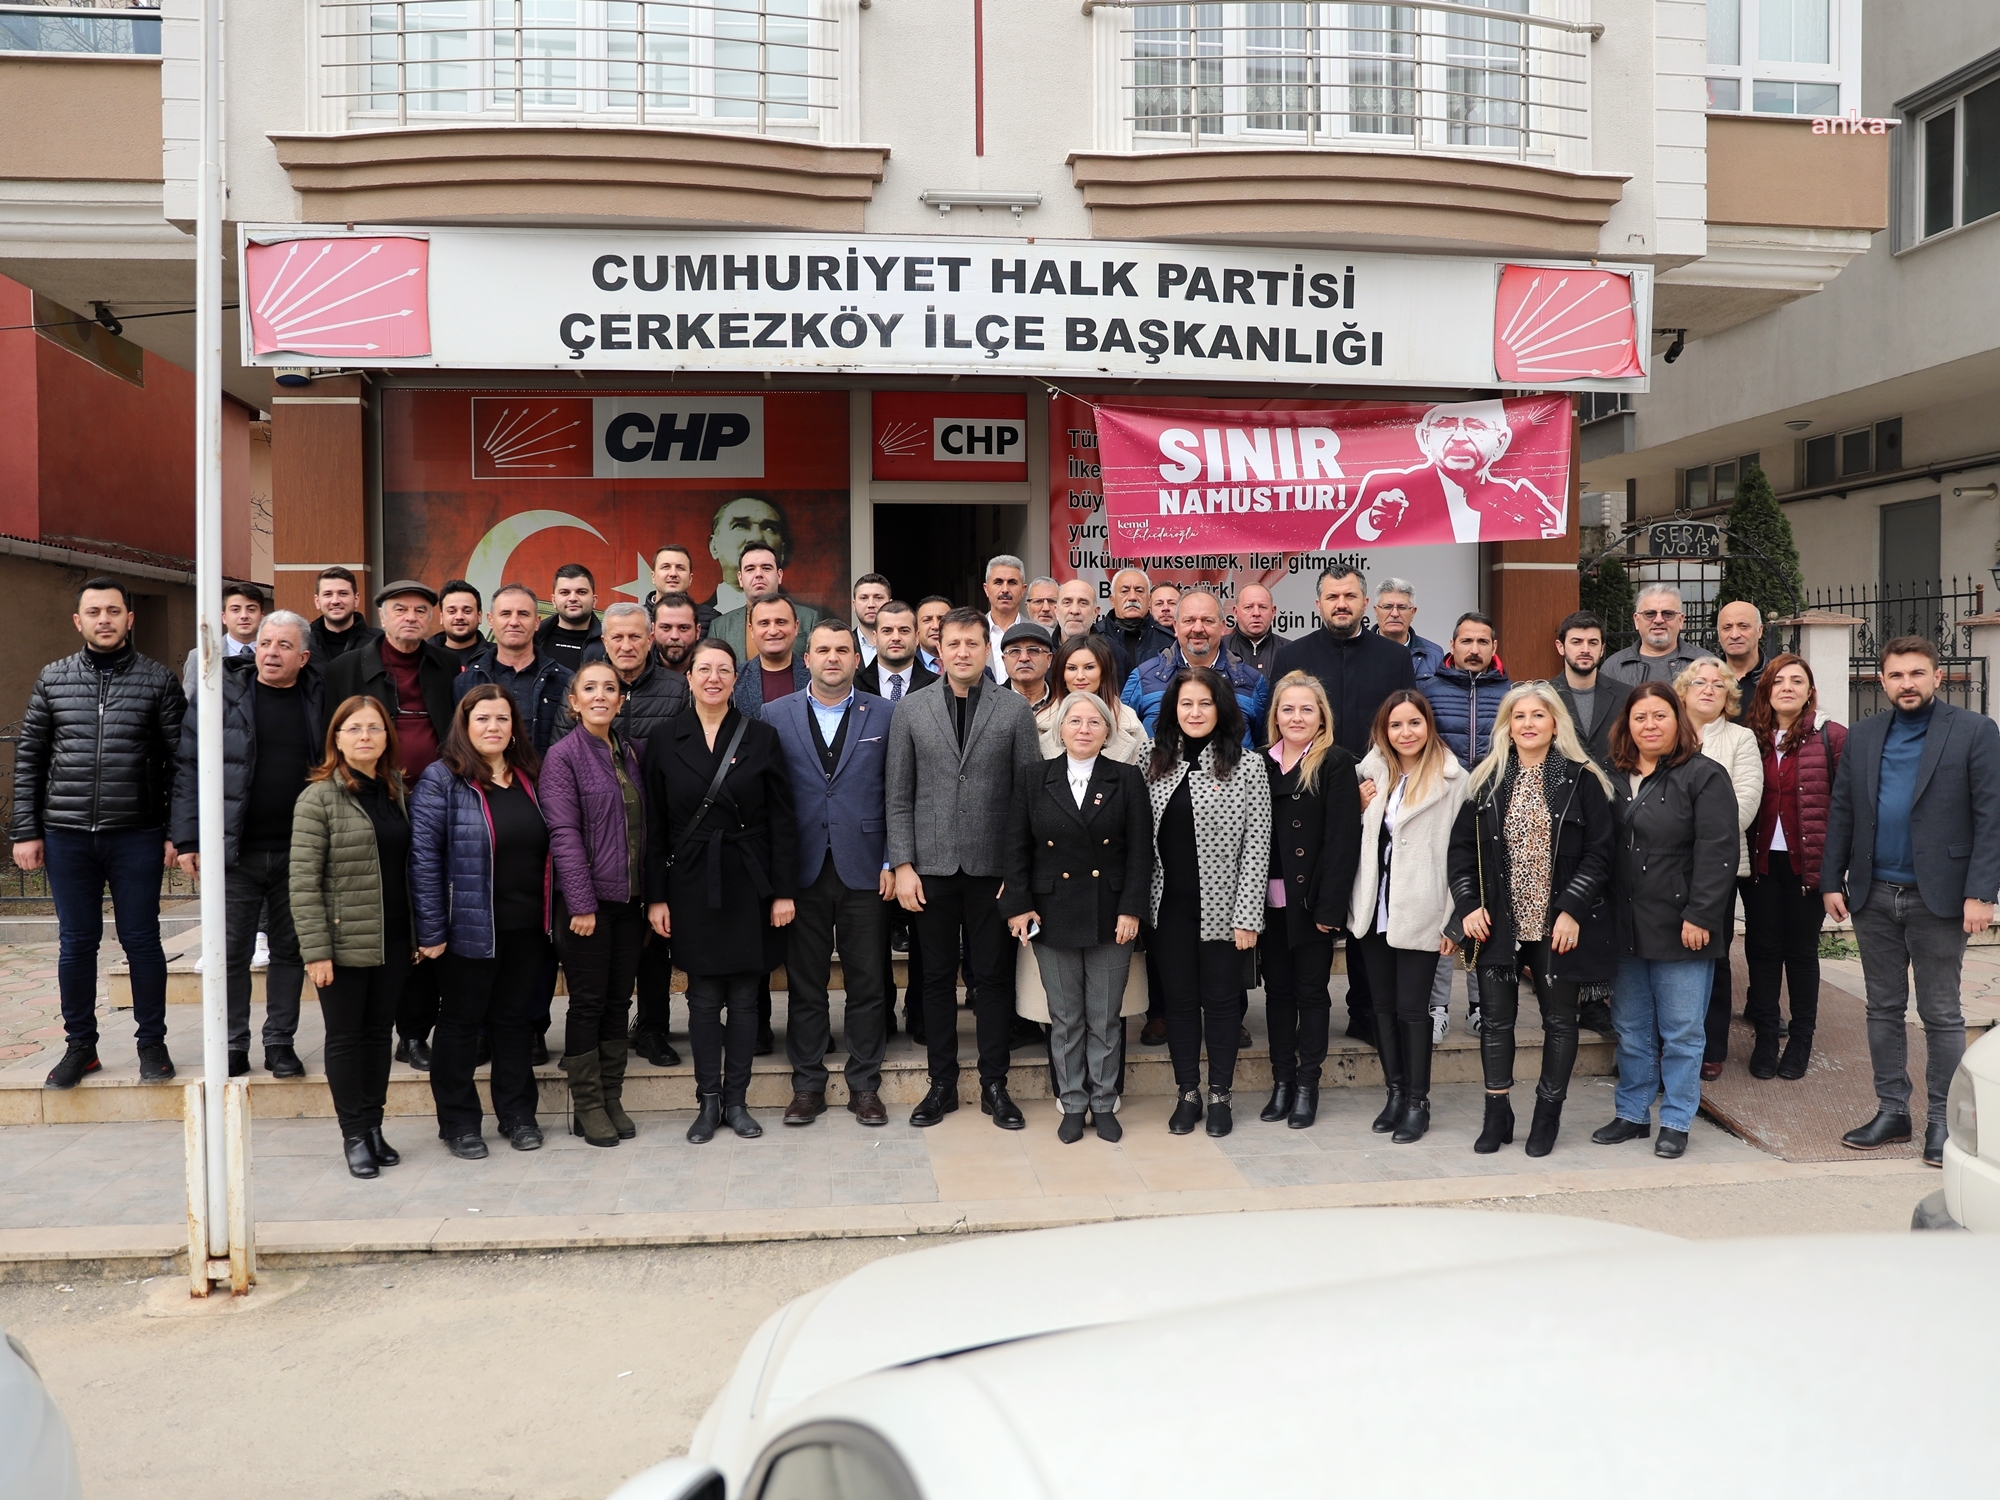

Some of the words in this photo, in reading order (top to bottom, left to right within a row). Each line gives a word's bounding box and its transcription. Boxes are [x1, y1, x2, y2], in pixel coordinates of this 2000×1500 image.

[591, 247, 972, 292] CUMHURİYET
[991, 258, 1139, 297] HALK
[1157, 263, 1355, 309] PARTİSİ
[559, 304, 905, 360] ÇERKEZKÖY
[925, 304, 1045, 359] İLÇE
[1065, 316, 1383, 367] BAŞKANLIĞI
[605, 412, 751, 463] CHP
[939, 423, 1019, 455] CHP
[1158, 427, 1345, 483] SINIR
[1158, 484, 1347, 515] NAMUSTUR!
[1117, 519, 1149, 529] kemal
[1250, 552, 1282, 570] ileri
[1288, 552, 1371, 574] gitmektir.
